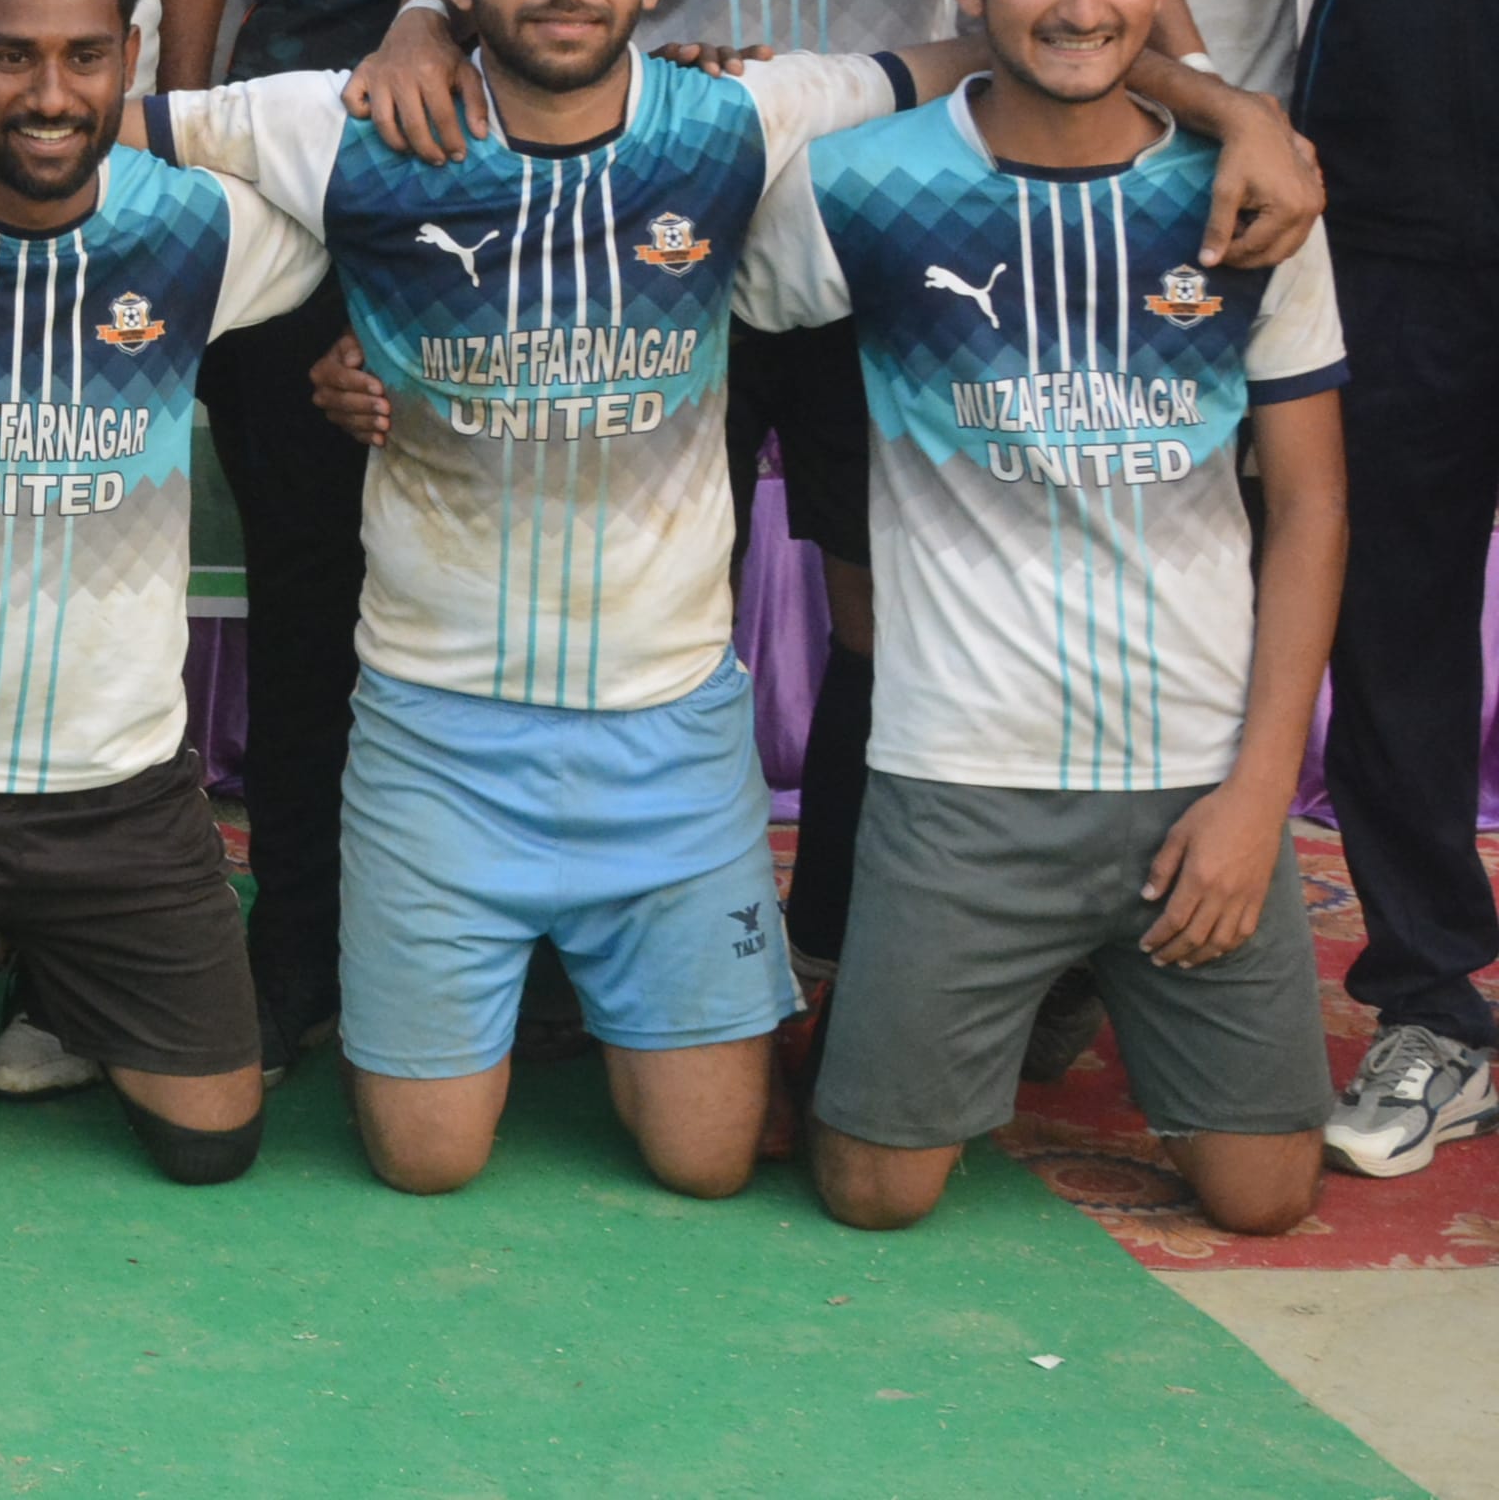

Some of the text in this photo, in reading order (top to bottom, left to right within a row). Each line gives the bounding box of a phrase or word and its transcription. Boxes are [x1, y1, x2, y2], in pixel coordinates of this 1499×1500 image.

[420, 325, 698, 388] MUZAFFARNAGAR
[449, 390, 665, 443] UNITED
[950, 370, 1205, 434] MUZAFFARNAGAR
[986, 439, 1193, 488] UNITED
